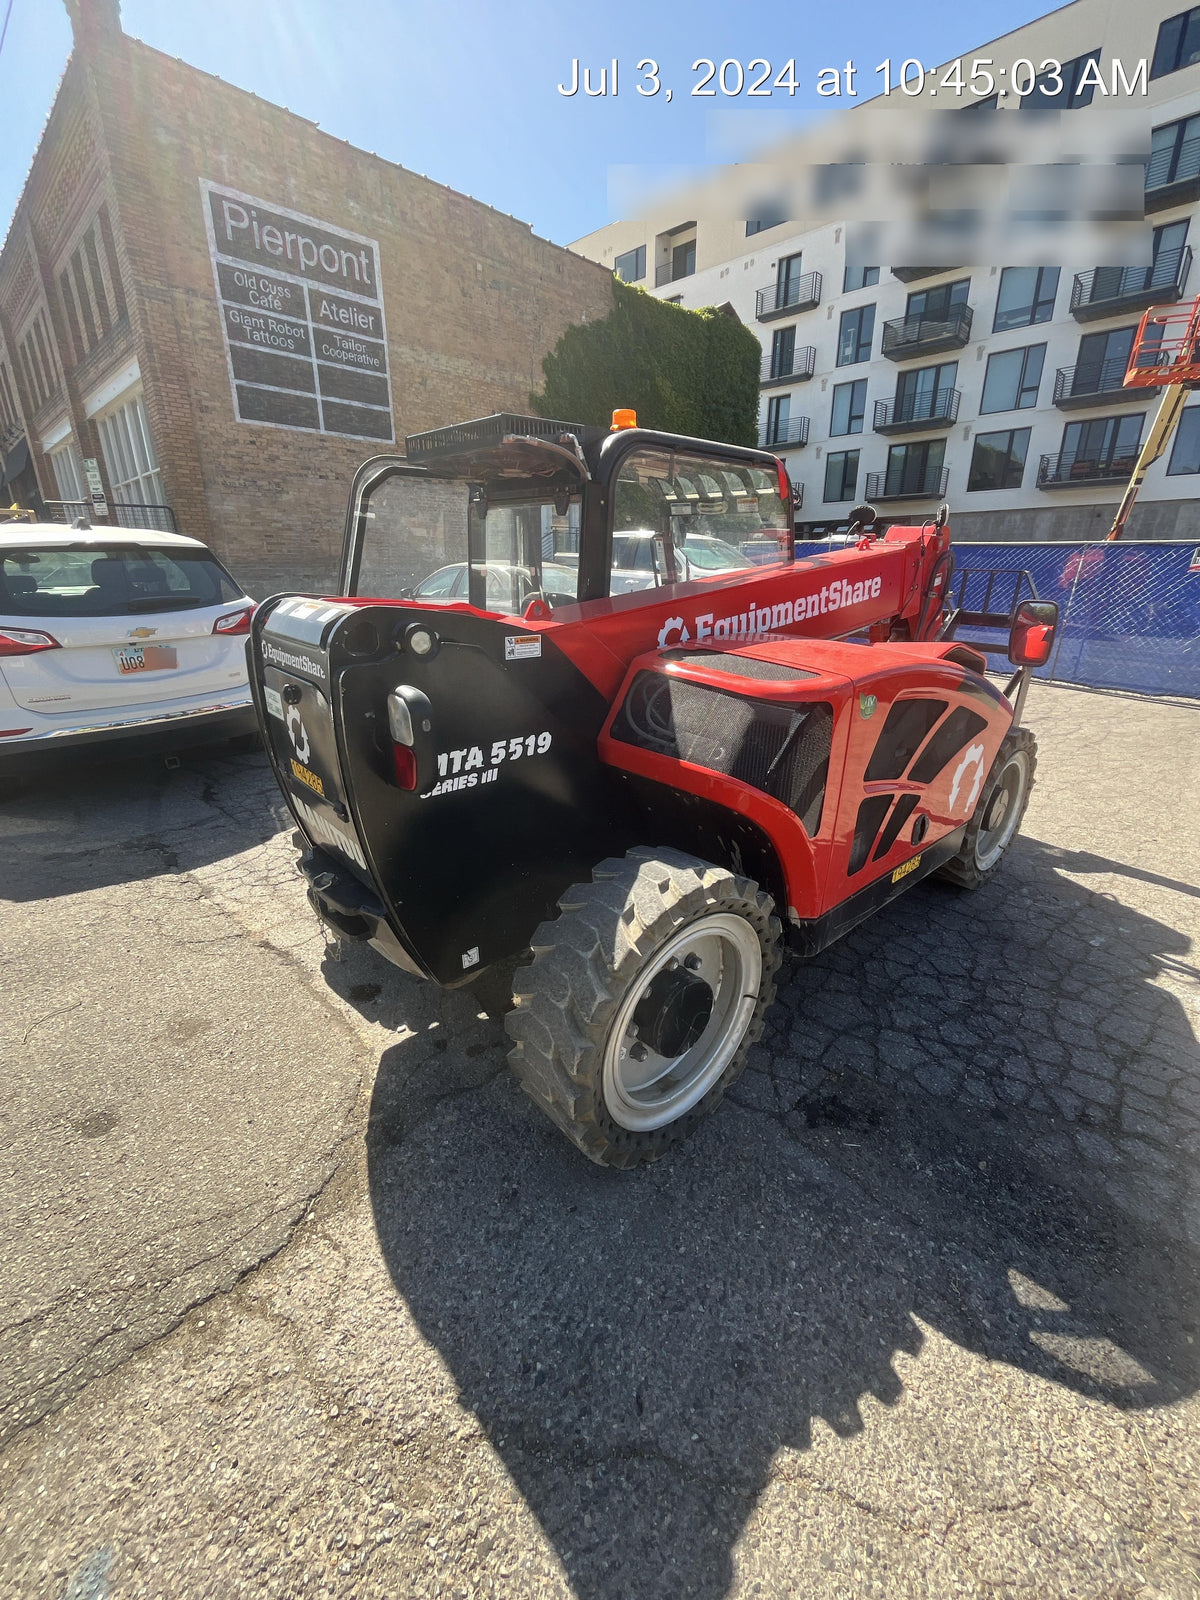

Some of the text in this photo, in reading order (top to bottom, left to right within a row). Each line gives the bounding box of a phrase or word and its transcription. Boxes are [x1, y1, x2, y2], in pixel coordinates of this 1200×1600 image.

[222, 200, 371, 284] Pierpont
[234, 271, 291, 299] Old Cuss
[249, 290, 283, 311] Café
[319, 300, 375, 330] Atelier
[229, 310, 306, 340] Giant Robot
[243, 325, 295, 350] Tattoos
[322, 344, 380, 367] Cooperative
[333, 335, 367, 351] Tailor
[695, 576, 882, 640] EquipmentShare
[490, 731, 552, 765] 5519
